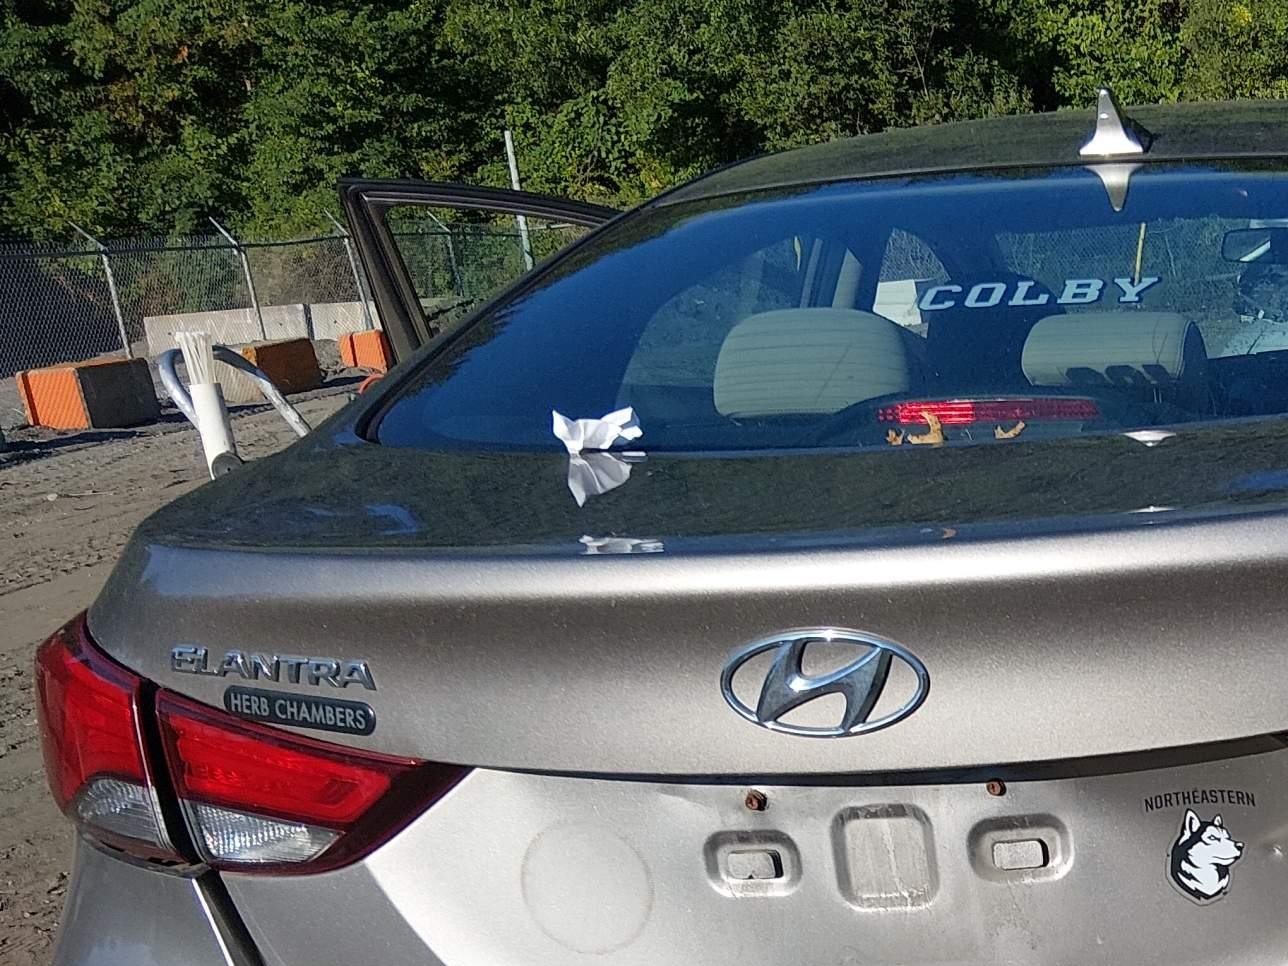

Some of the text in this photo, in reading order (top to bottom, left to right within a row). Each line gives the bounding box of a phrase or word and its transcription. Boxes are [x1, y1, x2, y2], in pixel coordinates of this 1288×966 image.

[917, 276, 1160, 312] COLBY
[170, 645, 377, 691] ELANTRA
[230, 693, 367, 730] HERB CHAMBERS
[1144, 789, 1257, 813] NORTHEASTERN
